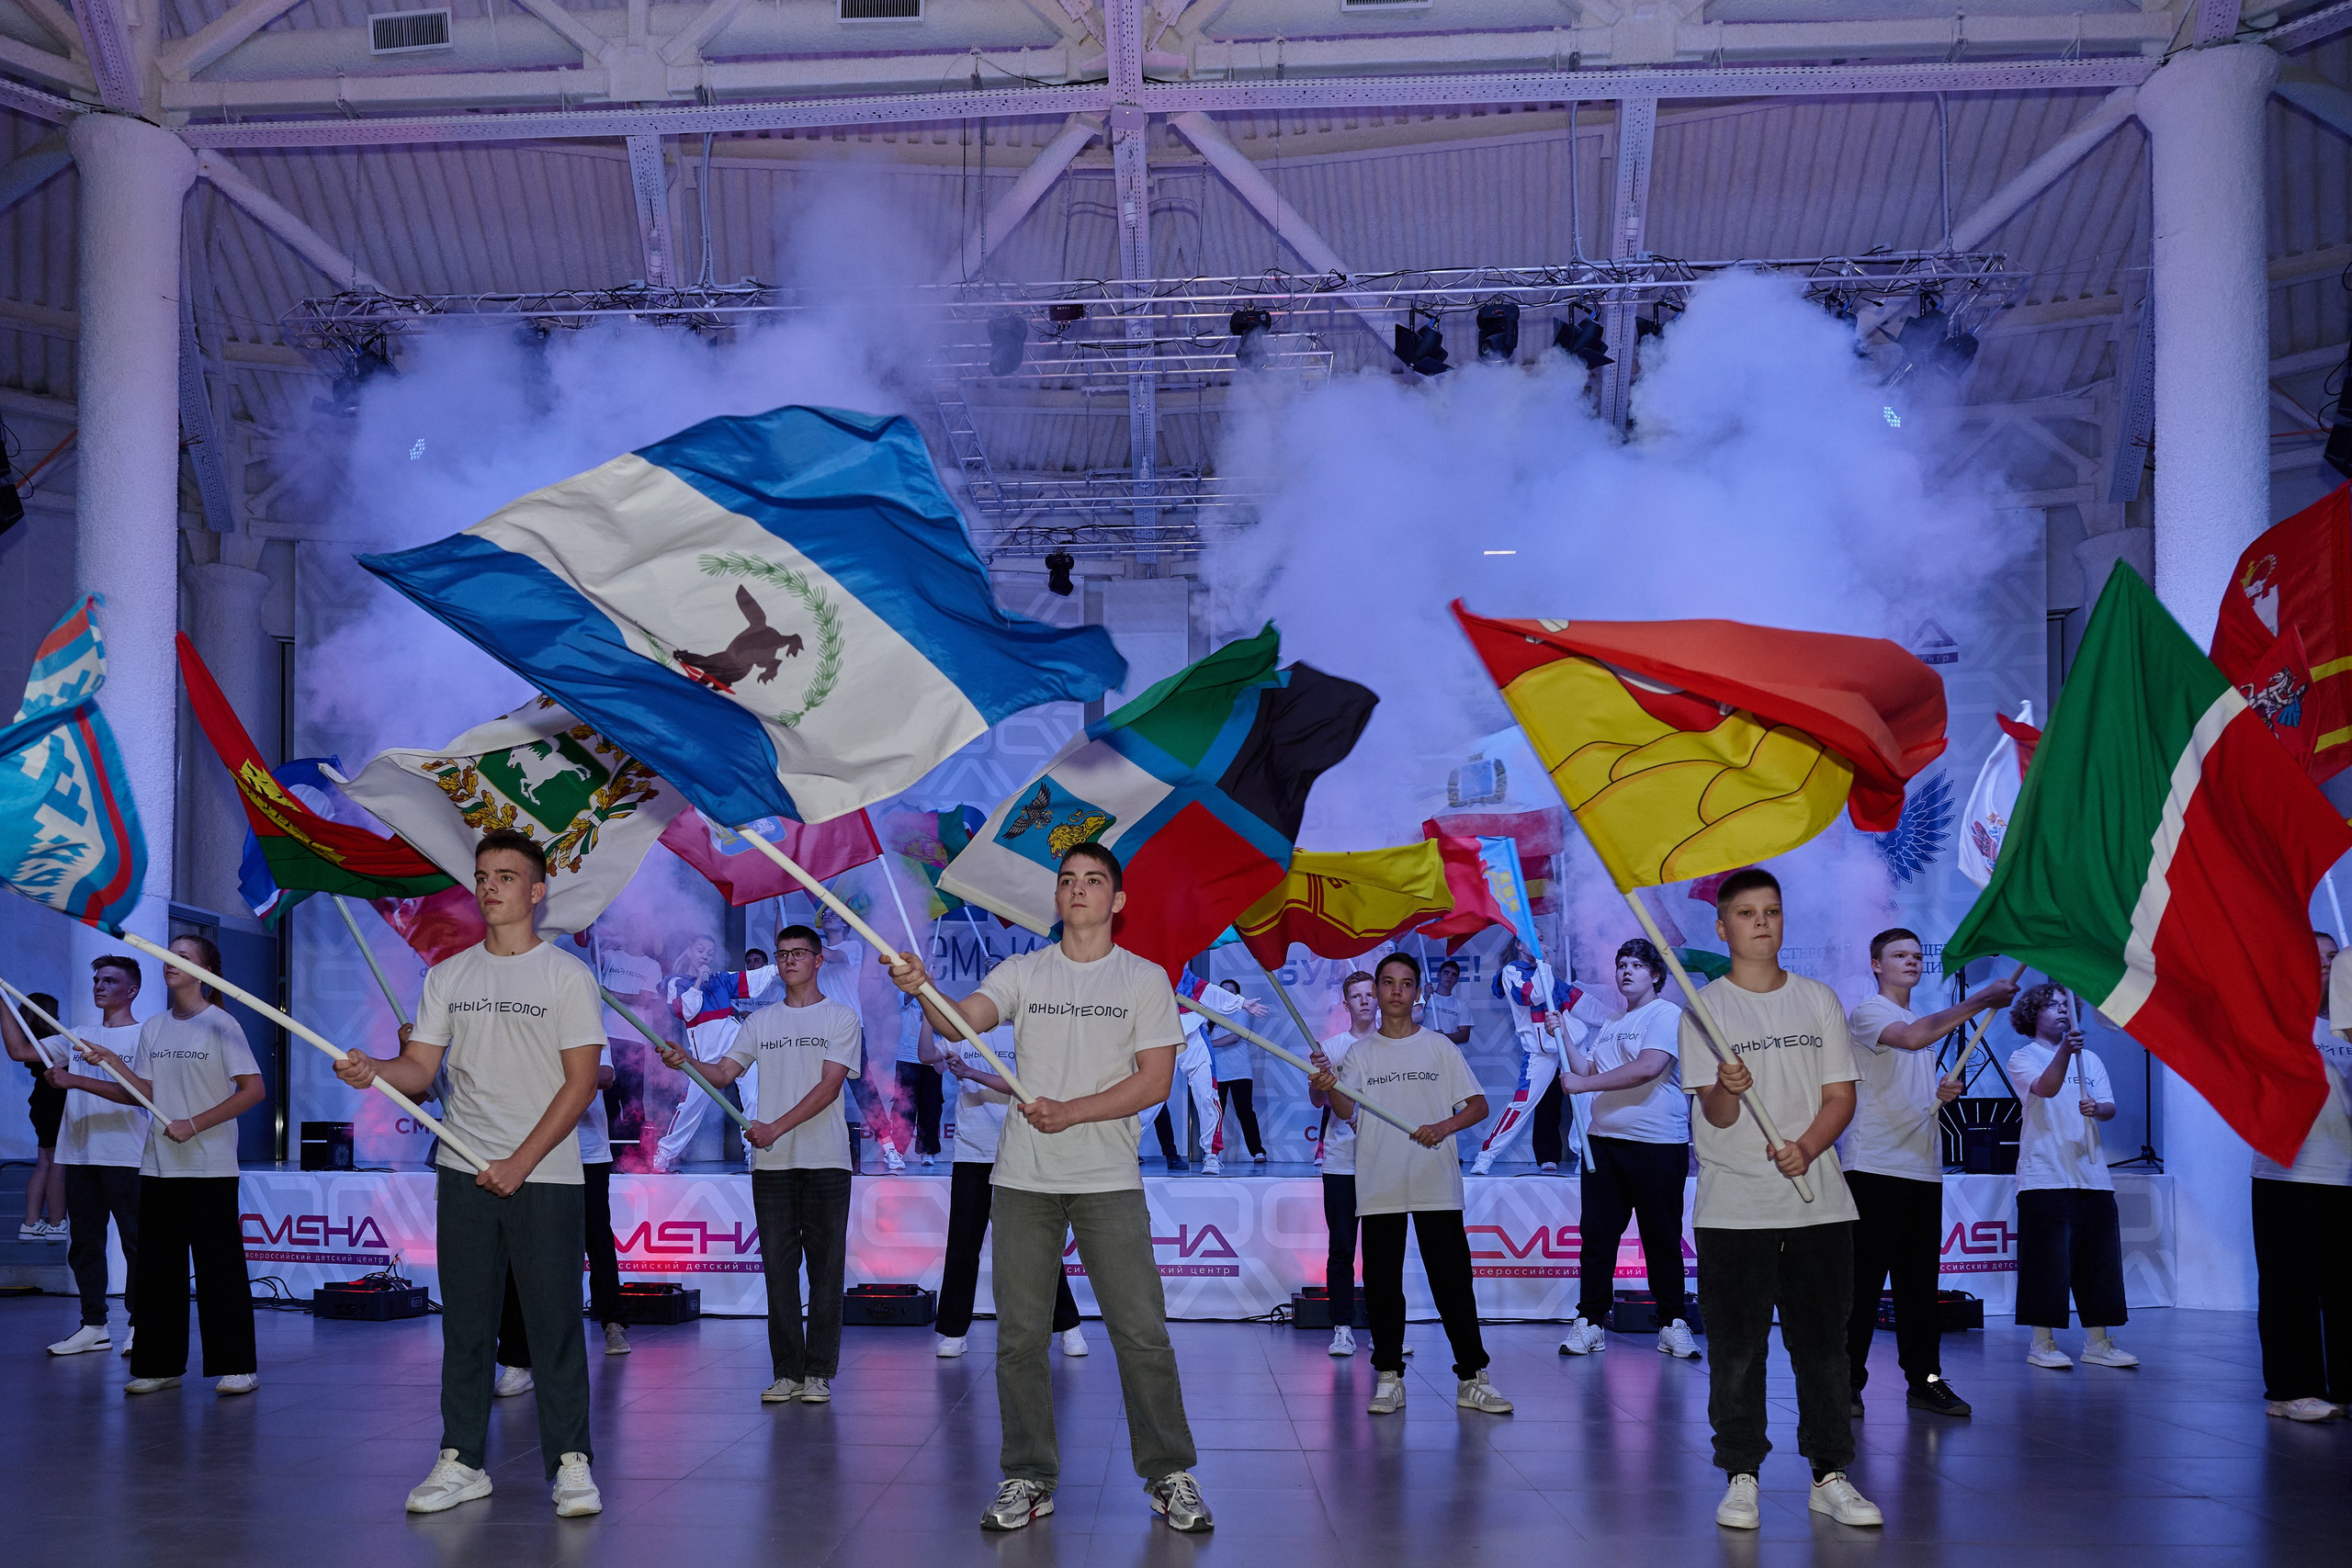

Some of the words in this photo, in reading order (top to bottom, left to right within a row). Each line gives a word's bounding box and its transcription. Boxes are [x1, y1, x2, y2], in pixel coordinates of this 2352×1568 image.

[1921, 655, 1950, 663] ентр
[448, 998, 492, 1013] ЮНЫЙ
[495, 1002, 548, 1018] ГЕОЛОГ
[1028, 1002, 1074, 1015] ЮНЫЙ
[1075, 1005, 1128, 1019] ГЕОЛОГ
[761, 1036, 792, 1050] НЫЙ
[1776, 1034, 1823, 1049] ГЕОЛО
[173, 1051, 209, 1060] ГЕОЛОГ
[1366, 1071, 1400, 1086] ЮНЫЙ
[239, 1213, 390, 1247] СМЕНА
[245, 1252, 311, 1261] всероссийский
[315, 1255, 353, 1264] детский
[356, 1257, 384, 1265] центр
[685, 1262, 739, 1271] детский
[1191, 1267, 1230, 1276] центр
[1472, 1267, 1578, 1277] всероссийский
